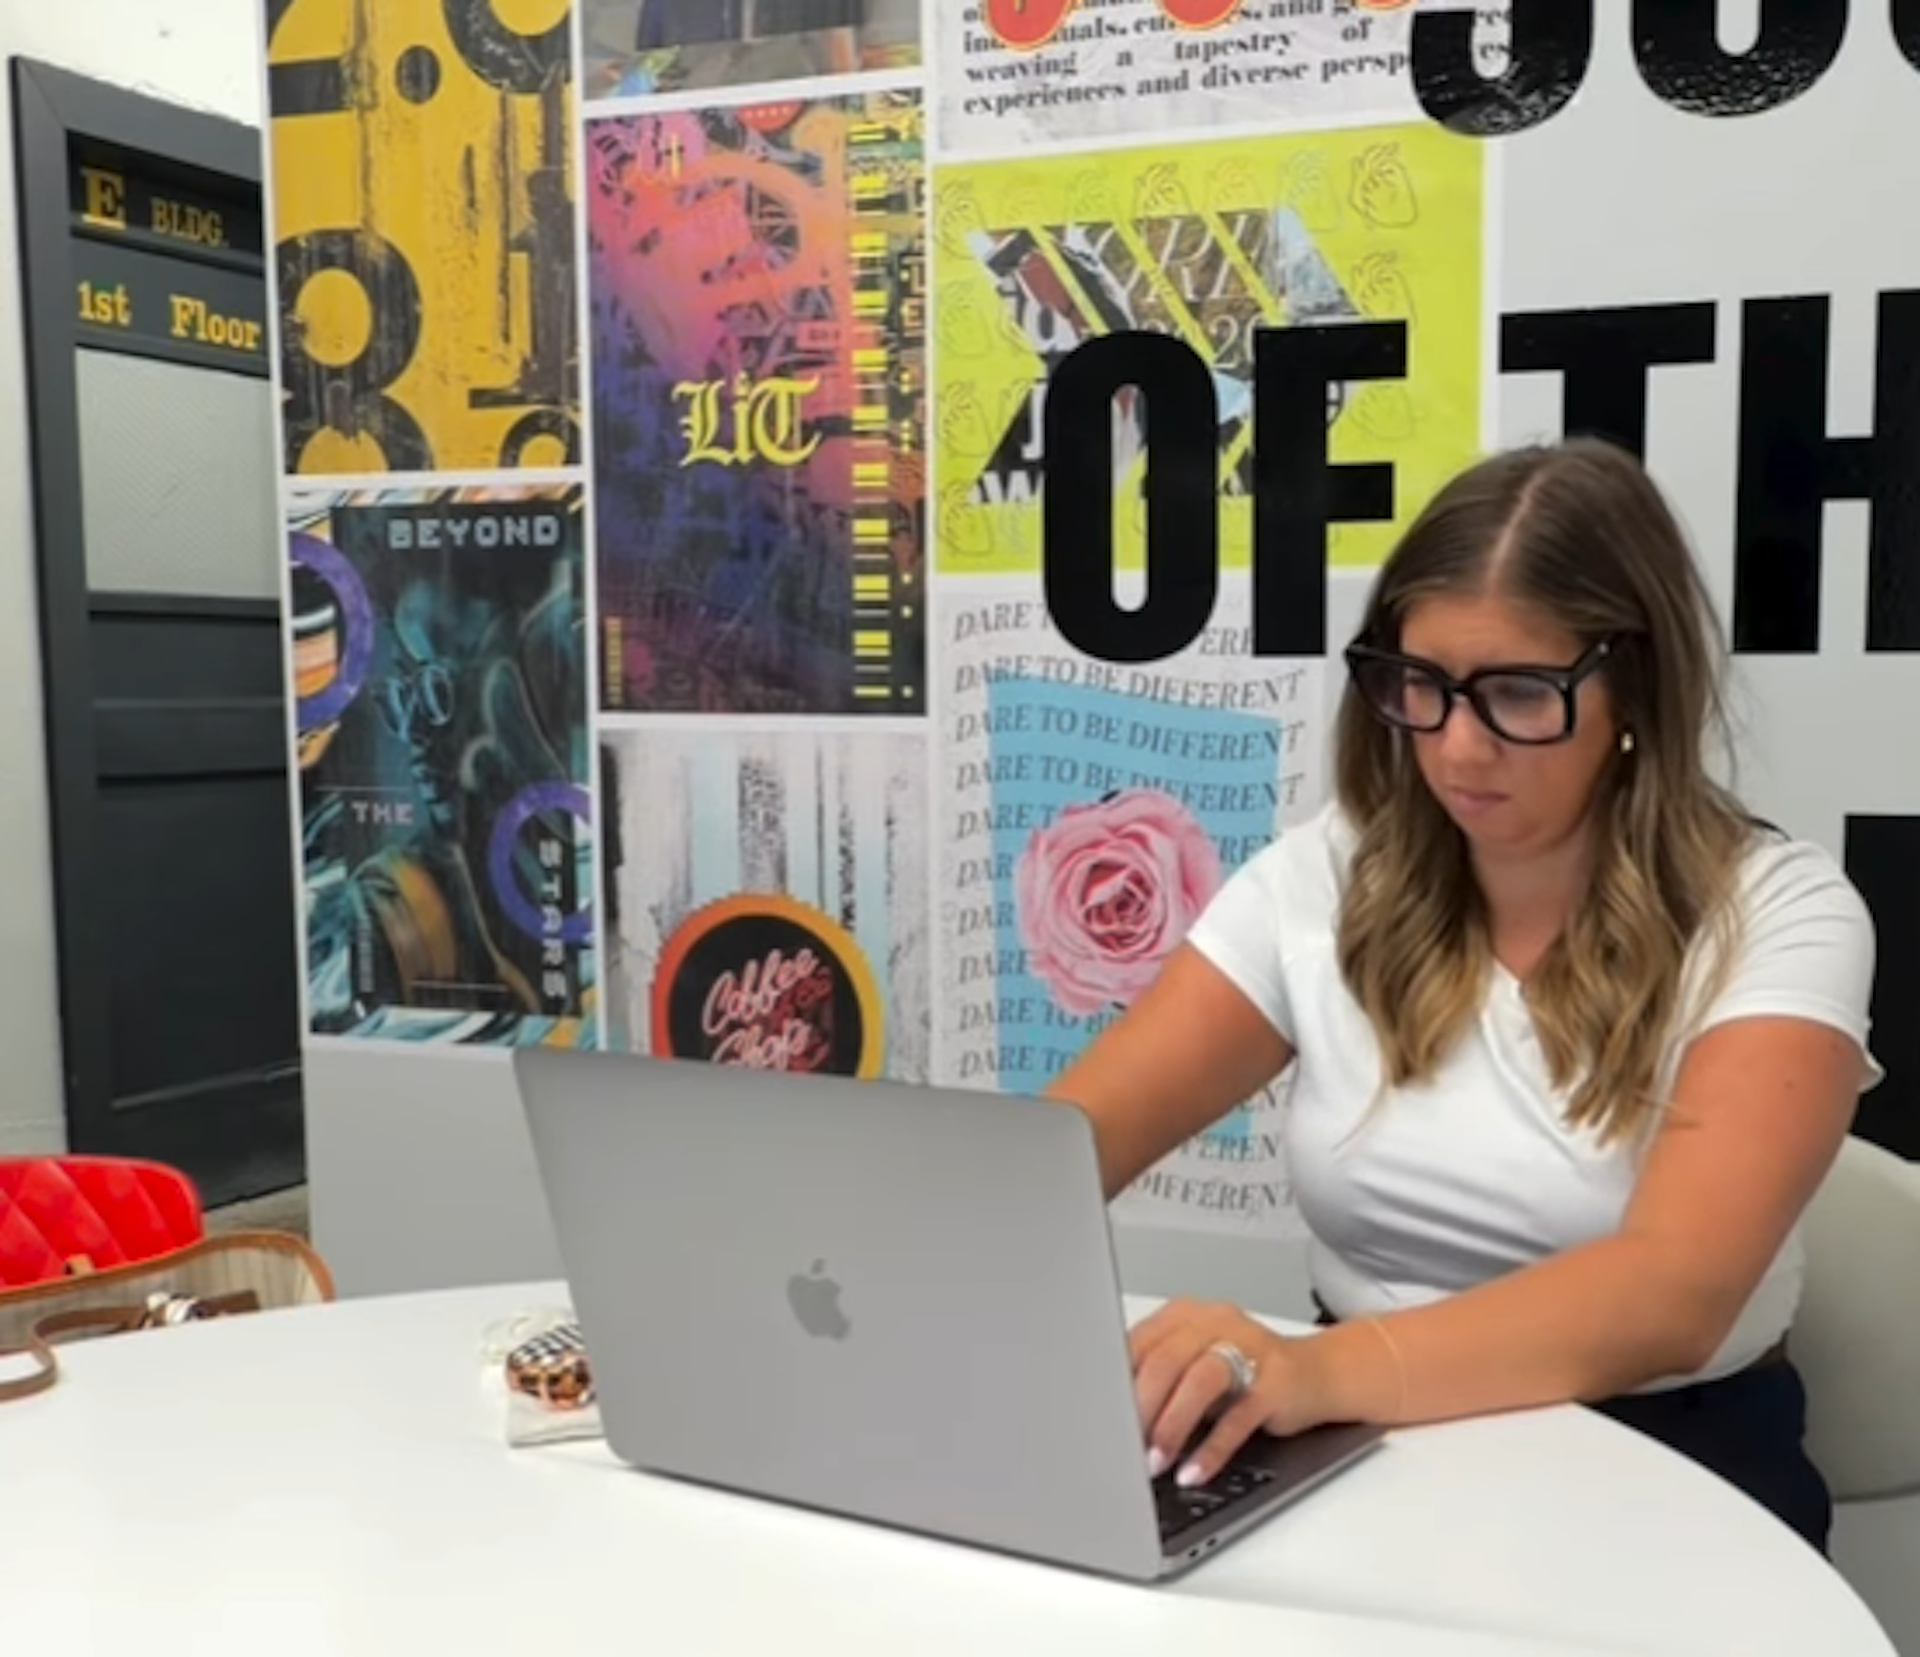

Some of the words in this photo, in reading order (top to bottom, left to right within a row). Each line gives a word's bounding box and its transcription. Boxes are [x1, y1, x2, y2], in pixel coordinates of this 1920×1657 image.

[965, 52, 1078, 83] weaving
[1116, 50, 1134, 67] a
[1174, 30, 1296, 64] tapestry
[1341, 16, 1373, 42] of
[963, 82, 1127, 117] experiences
[1136, 68, 1190, 97] and
[1201, 62, 1310, 90] diverse
[80, 167, 127, 231] E
[151, 197, 230, 249] BLDG.
[78, 280, 132, 328] 1st
[169, 293, 262, 349] Floor
[1042, 320, 1408, 663] OF
[387, 514, 560, 549] BEYOND
[953, 602, 1032, 642] DARE
[954, 656, 1033, 693] DARE
[1038, 656, 1079, 684] TO
[1083, 665, 1122, 699] BE
[1128, 669, 1305, 710] DIFFERENT
[955, 705, 1033, 743] DARE
[1038, 706, 1080, 734] TO
[1084, 716, 1122, 745] BE
[1128, 721, 1305, 756] DIFFERENT
[956, 756, 1033, 792] DARE
[1039, 756, 1080, 782] TO
[352, 801, 415, 825] THE
[957, 805, 1032, 841] DARE
[538, 839, 568, 998] STARS
[701, 948, 820, 1036] Coffee
[958, 998, 1036, 1033] DARE
[958, 1046, 1036, 1080] DARE
